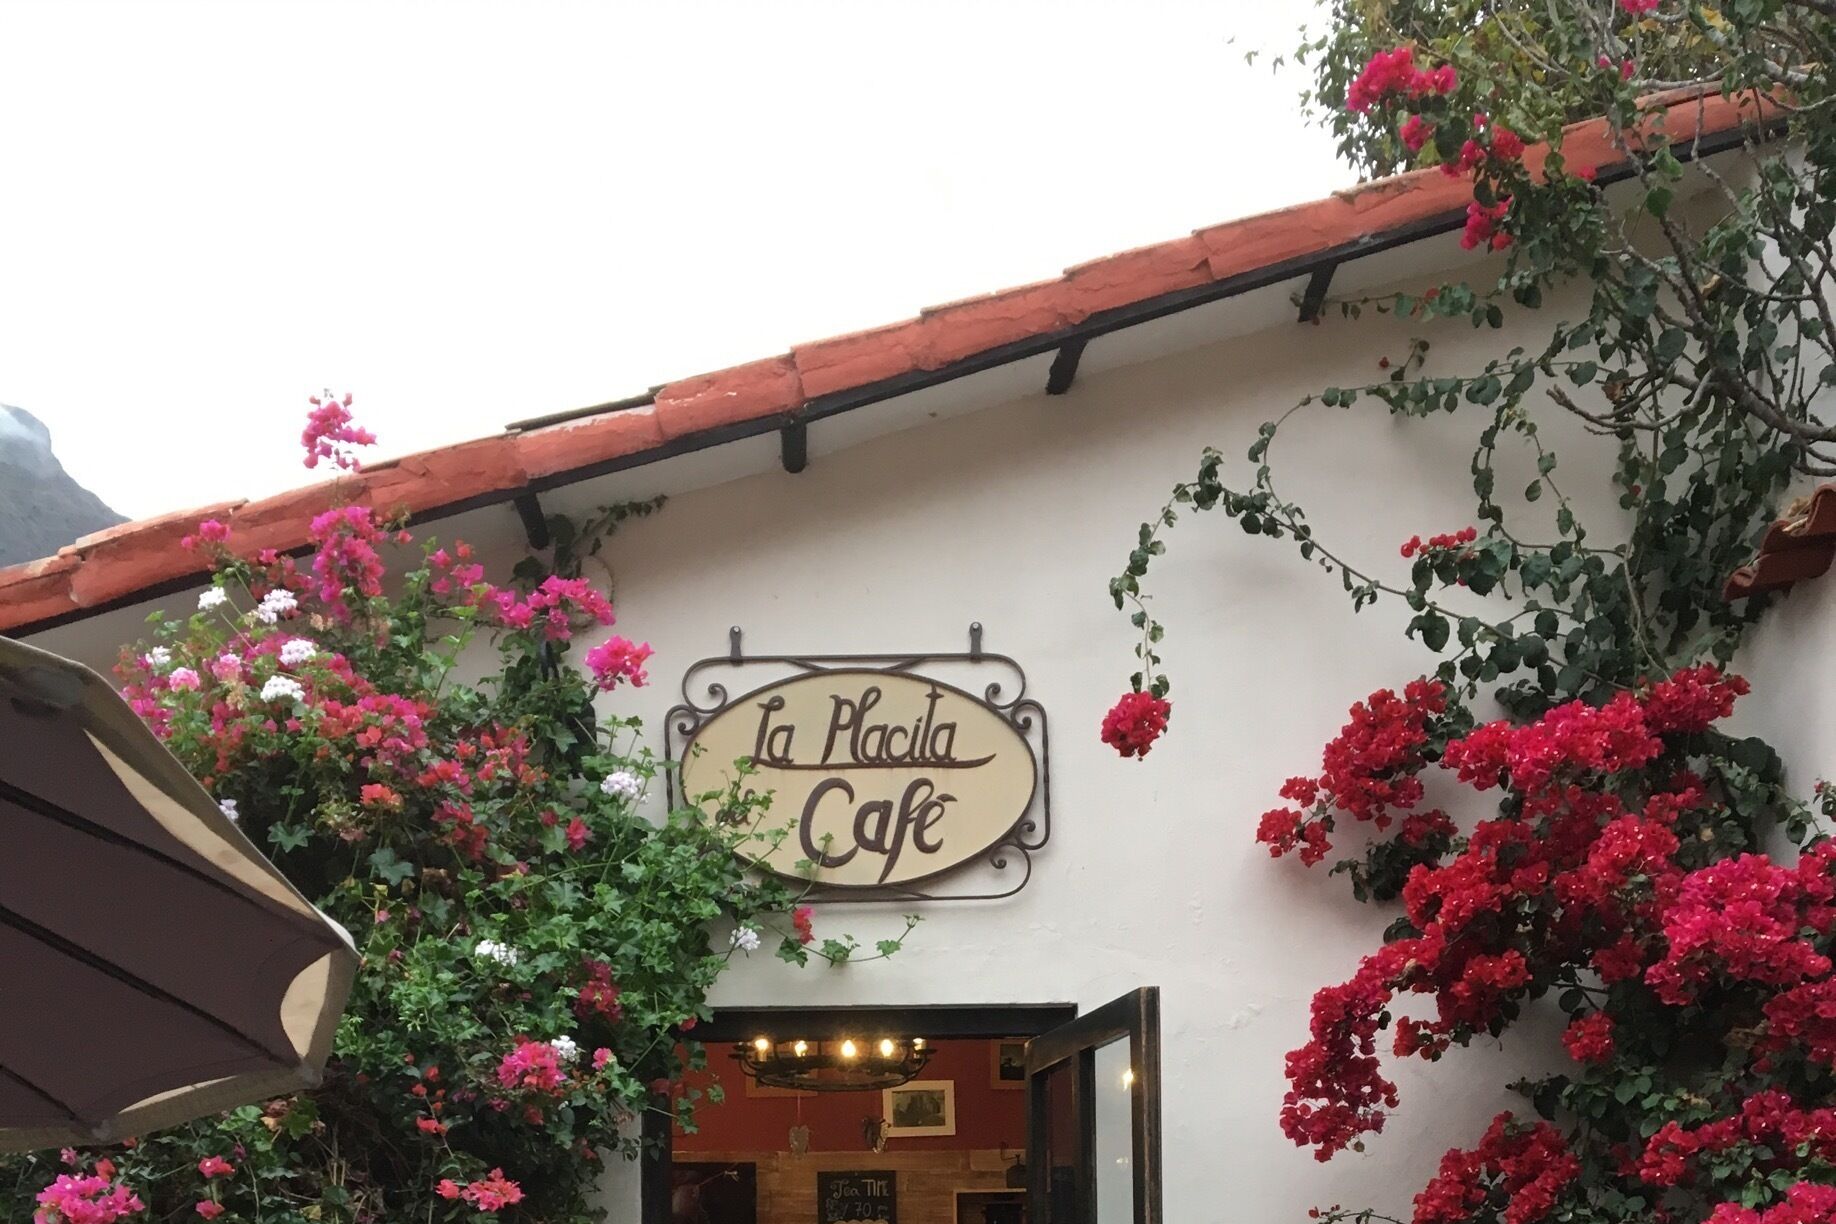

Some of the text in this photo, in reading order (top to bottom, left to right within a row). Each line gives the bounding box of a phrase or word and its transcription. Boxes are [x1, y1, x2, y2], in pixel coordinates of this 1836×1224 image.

[750, 686, 958, 767] La Placita
[800, 777, 958, 885] Café
